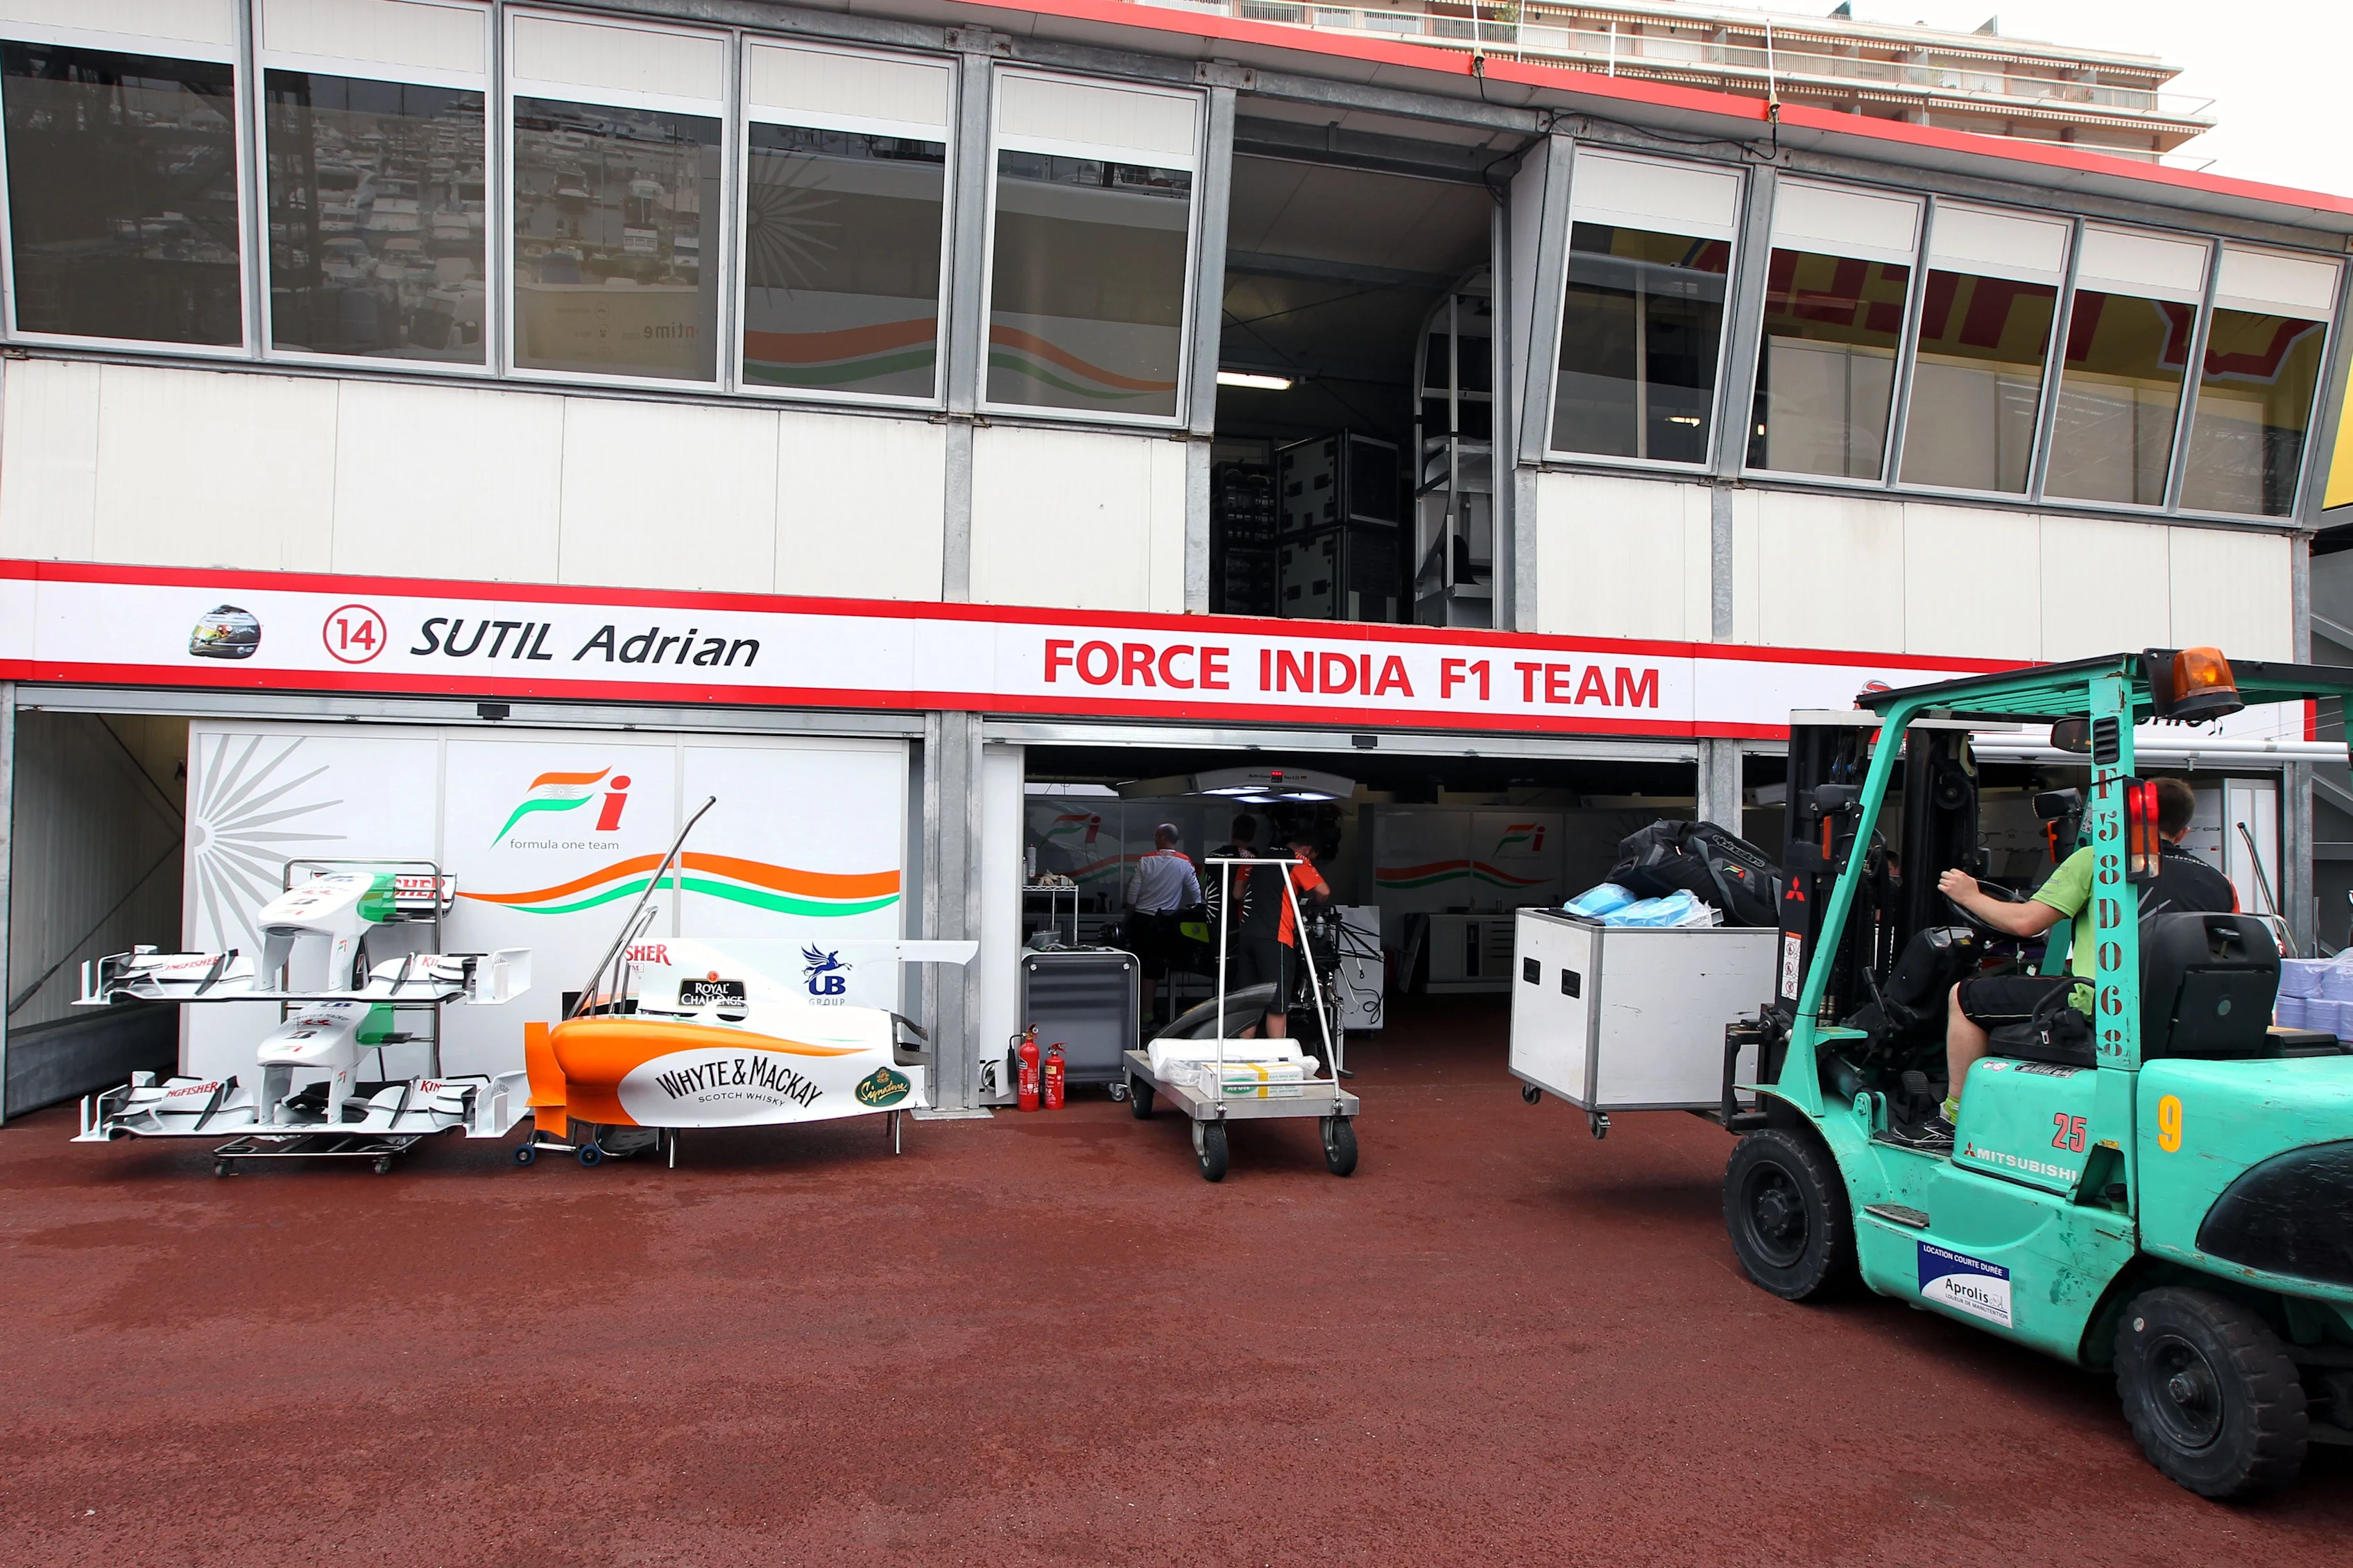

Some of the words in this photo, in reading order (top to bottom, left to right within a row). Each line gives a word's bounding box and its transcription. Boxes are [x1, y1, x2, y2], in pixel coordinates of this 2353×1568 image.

[337, 618, 376, 651] 14
[410, 617, 553, 660] SUTIL
[572, 624, 760, 667] Adrian
[1044, 639, 1230, 690] FORCE
[1259, 648, 1415, 698] INDIA
[1441, 657, 1490, 701] F1
[1514, 662, 1659, 708] TEAM
[510, 838, 558, 850] formula
[561, 841, 585, 850] one
[588, 841, 619, 850] team
[695, 982, 730, 997] ROYAL
[809, 975, 846, 996] UB
[809, 998, 846, 1006] GROUP
[655, 1060, 730, 1100] WHYTE
[732, 1059, 748, 1085] &
[748, 1056, 824, 1109] MACKAY
[860, 1080, 908, 1103] Signature
[698, 1092, 743, 1103] SCOTCH
[746, 1093, 786, 1108] WHISKY
[2051, 1112, 2087, 1153] 25
[2157, 1094, 2183, 1153] 9
[1977, 1148, 2078, 1182] MITSUBISHI
[1923, 1244, 1953, 1260] LOCATION
[1953, 1255, 1980, 1268] COURTE
[1980, 1263, 2003, 1276] DURÉE
[1945, 1278, 1989, 1303] Aprolis
[1945, 1293, 1964, 1304] LOUEUR
[1971, 1302, 2008, 1320] MANUTENTION
